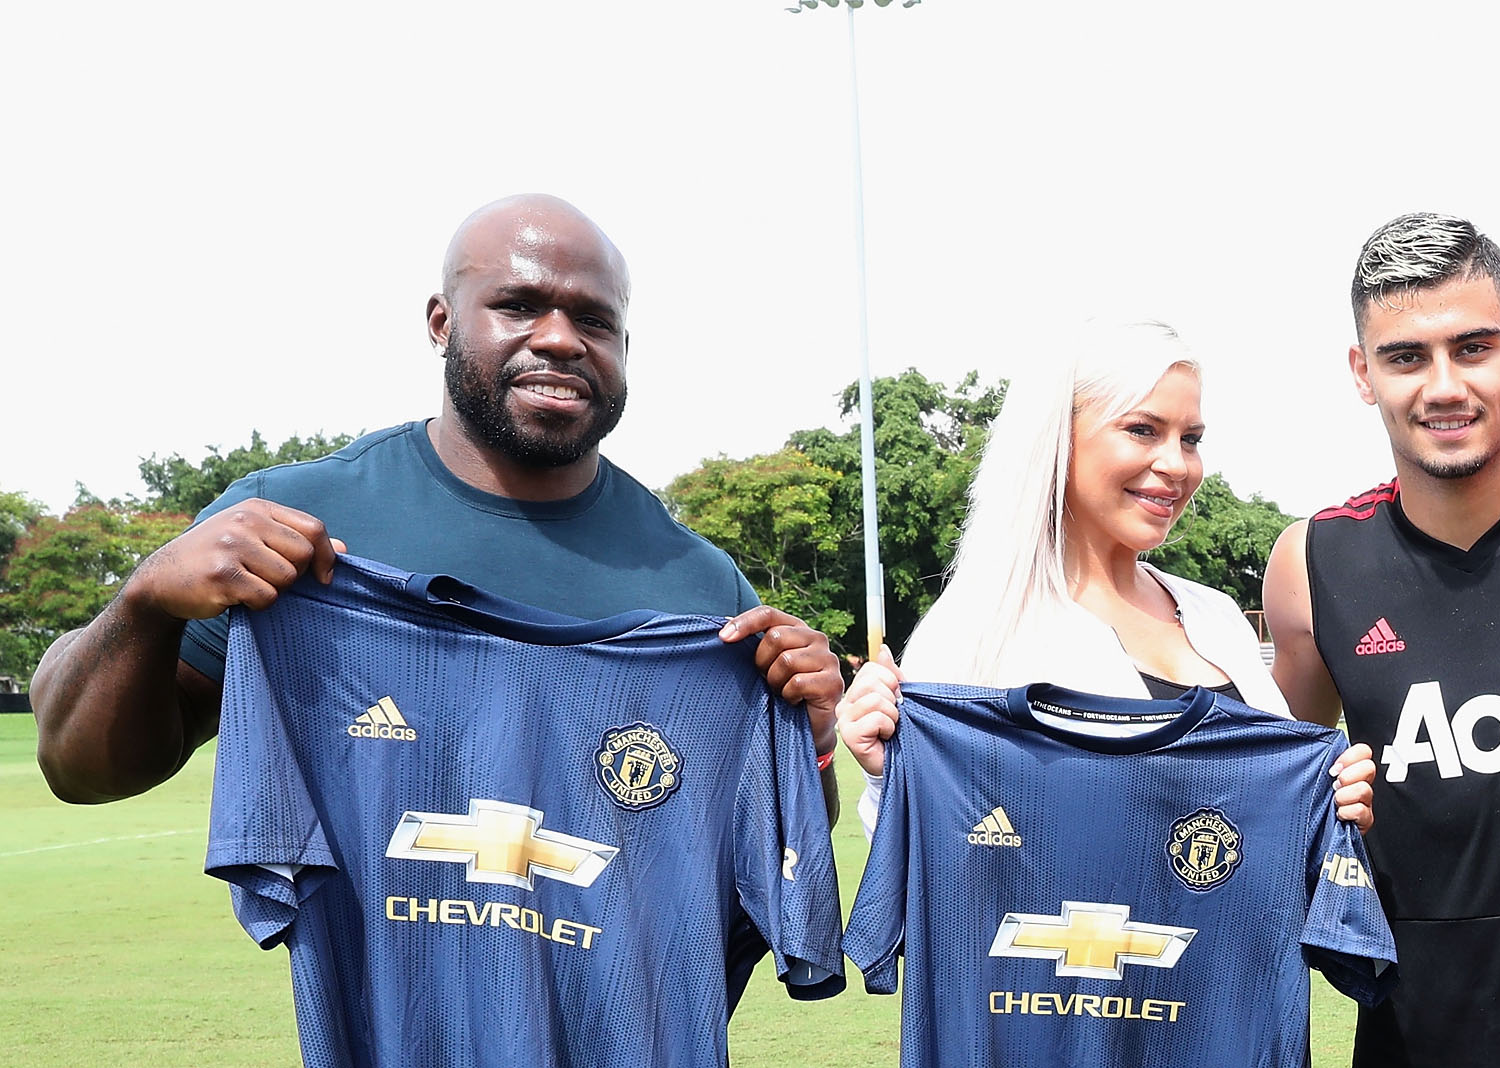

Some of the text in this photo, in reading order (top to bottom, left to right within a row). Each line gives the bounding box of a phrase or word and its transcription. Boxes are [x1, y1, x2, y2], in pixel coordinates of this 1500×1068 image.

[1355, 640, 1406, 656] adidas
[348, 721, 417, 741] adidas
[612, 732, 672, 768] MANCHESTER
[610, 780, 652, 801] UNITED
[967, 828, 1022, 847] adidas
[1179, 818, 1233, 846] MANCHESTER
[1181, 865, 1220, 881] UNITED
[386, 896, 602, 950] CHEVROLET
[988, 991, 1186, 1023] CHEVROLET
